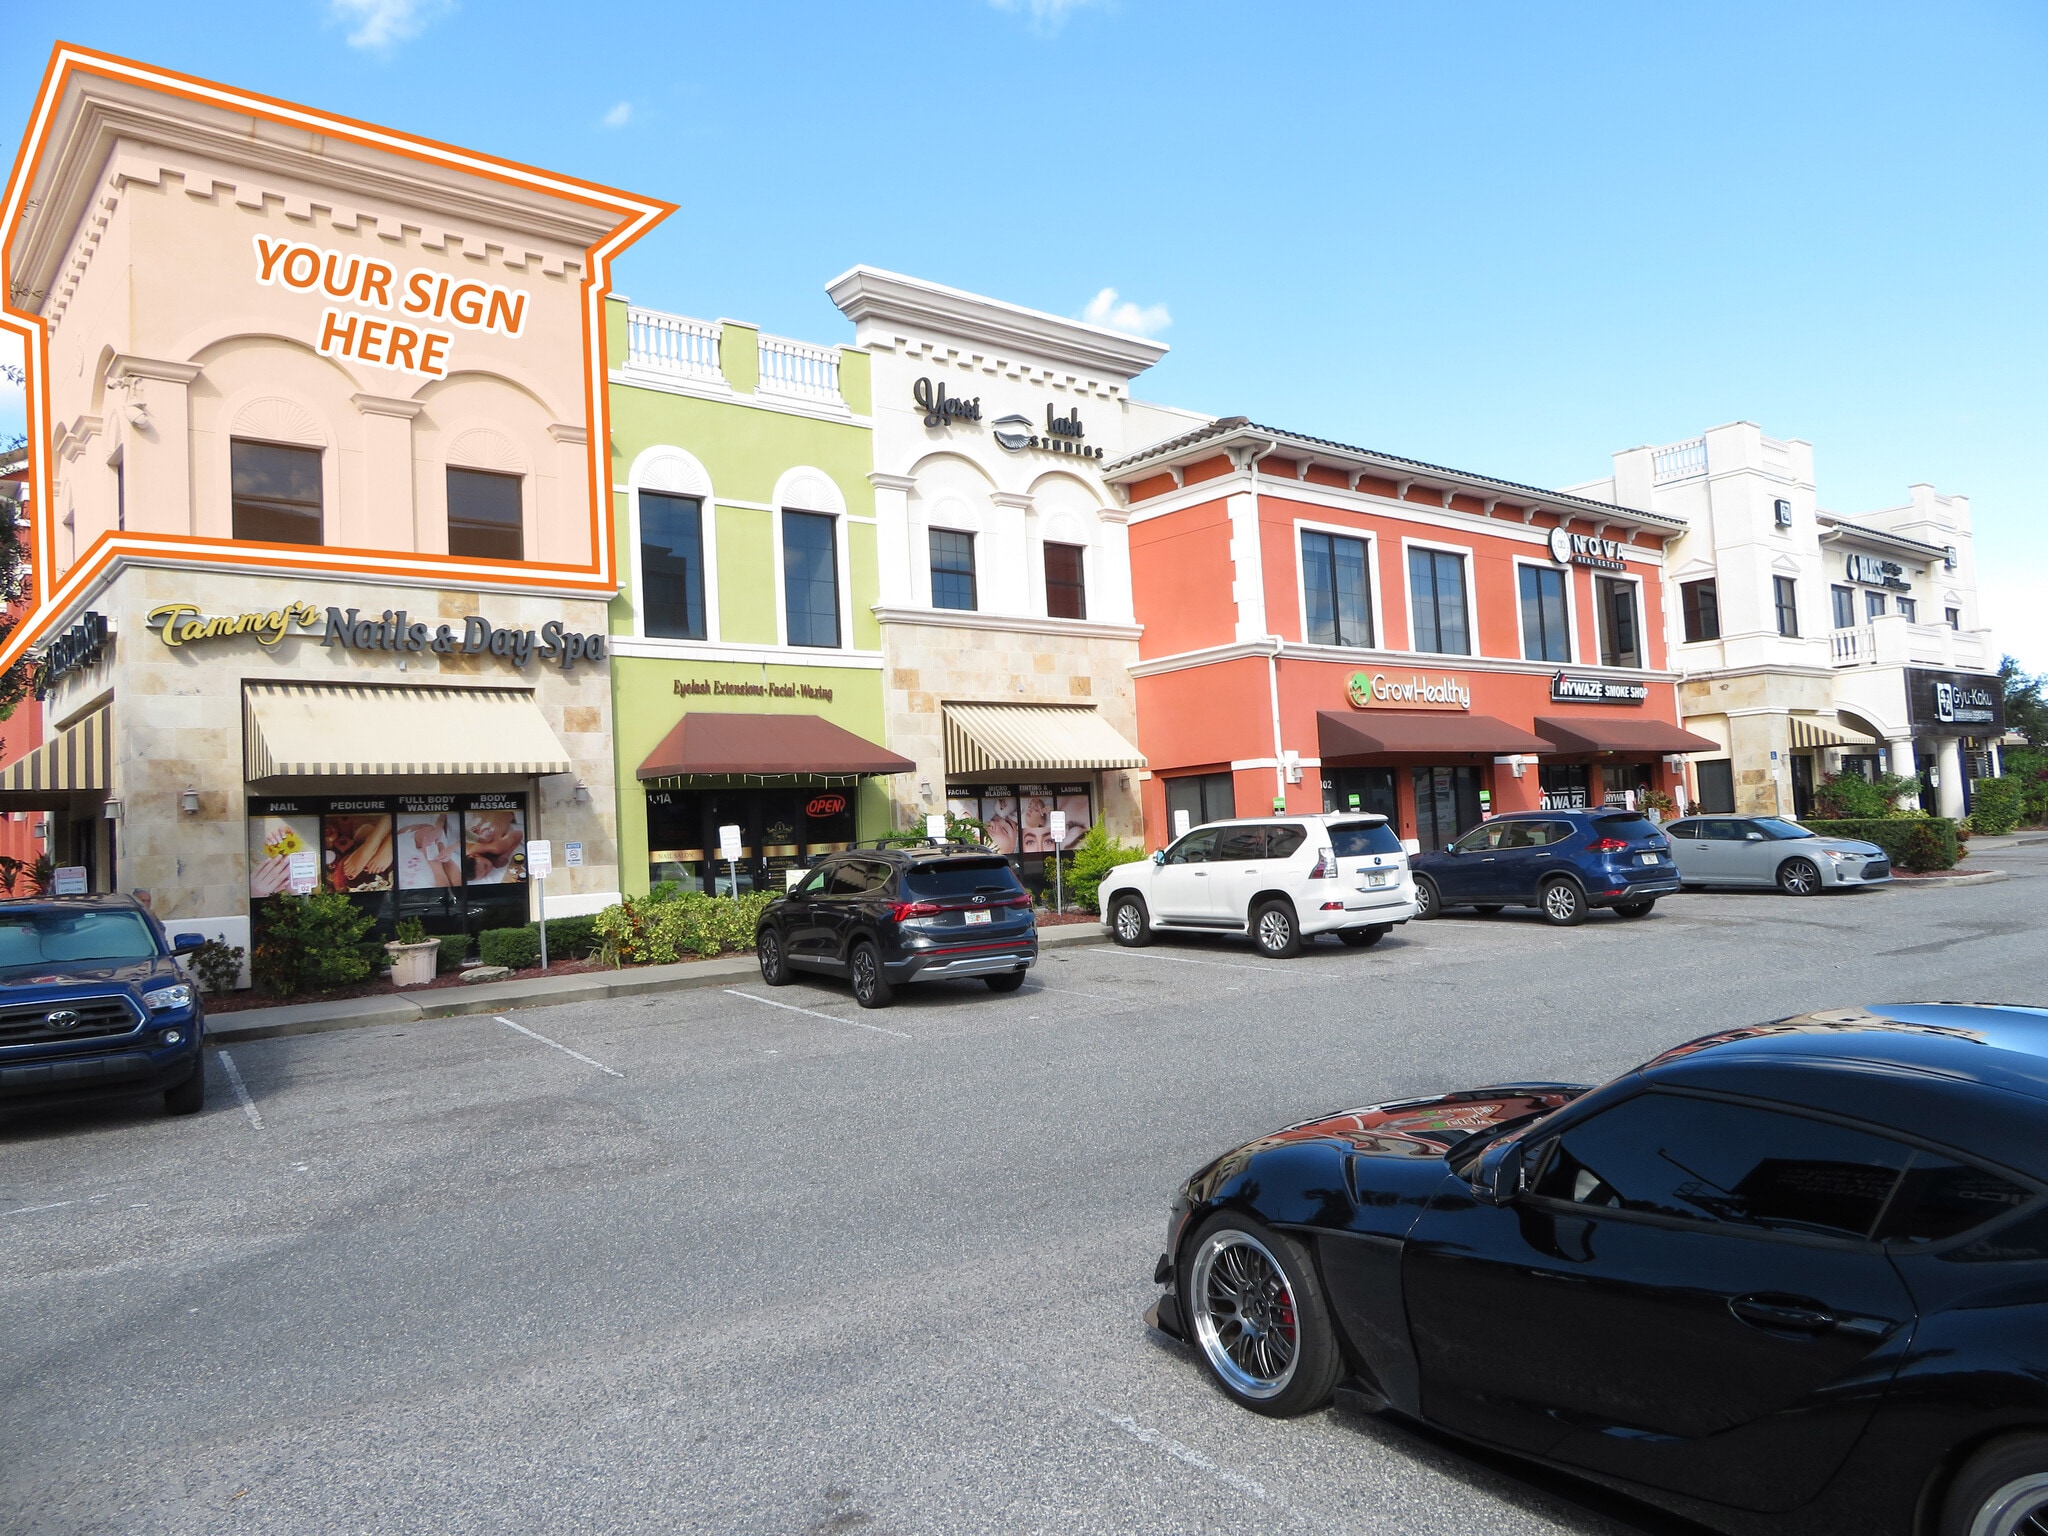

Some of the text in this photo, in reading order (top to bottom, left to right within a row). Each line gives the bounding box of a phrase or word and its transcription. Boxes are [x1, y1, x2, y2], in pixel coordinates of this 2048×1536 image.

[1028, 435, 1103, 459] STUDIOS
[1570, 533, 1626, 560] NOVA
[1577, 556, 1624, 570] REAL ESTATE
[147, 600, 321, 647] Tammy's
[320, 606, 428, 651] Nails
[431, 624, 457, 654] &
[460, 615, 536, 668] Day
[538, 620, 607, 670] Spa
[673, 679, 833, 703] Eyelash Extensions Facial Waxing
[1371, 673, 1471, 709] GrowHealthy
[1560, 680, 1649, 699] HYWAZE SMOKE SHOP
[1953, 686, 1993, 709] Gyu-Kaku
[399, 795, 456, 804] FULL BODY
[480, 794, 507, 802] BODY
[269, 803, 298, 812] NAIL
[330, 801, 386, 810] PEDICURE
[407, 803, 449, 812] WAXING
[470, 801, 518, 810] MASSAGE
[809, 799, 841, 813] OPEN
